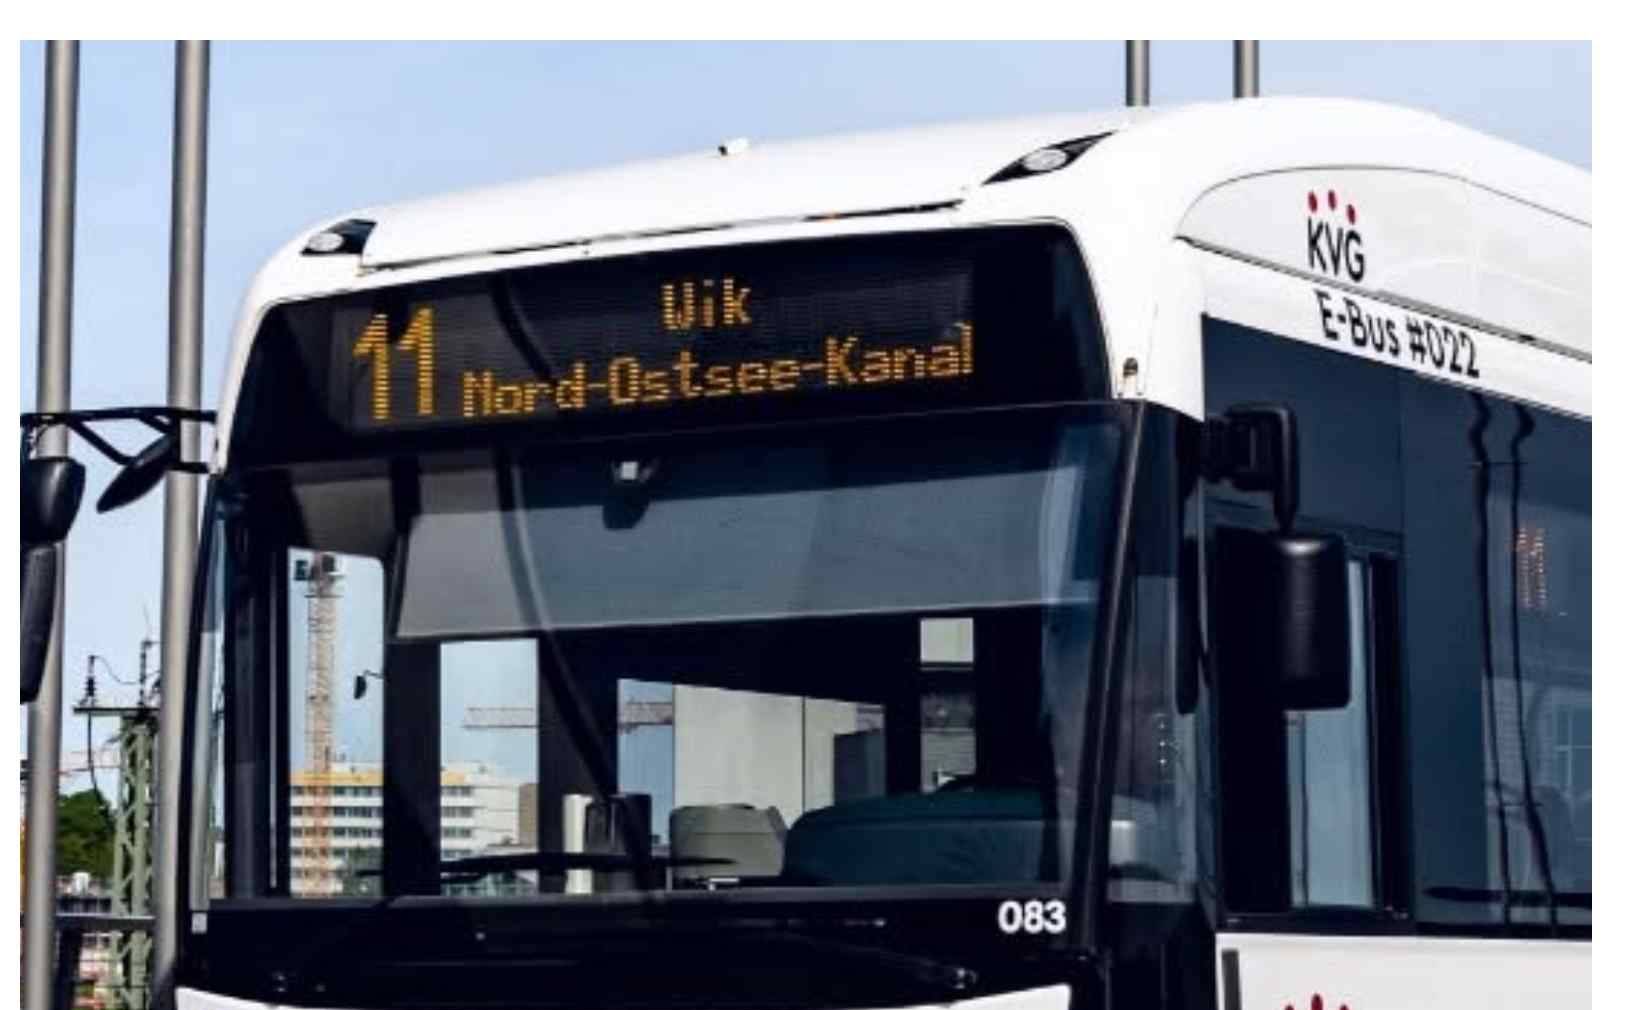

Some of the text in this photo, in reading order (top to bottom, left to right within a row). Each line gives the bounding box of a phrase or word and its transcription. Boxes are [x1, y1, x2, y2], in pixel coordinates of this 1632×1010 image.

[1307, 216, 1364, 283] KVG
[661, 278, 752, 330] Wik
[1314, 288, 1480, 379] E-Bus #022
[353, 307, 435, 420] 11
[463, 322, 974, 418] Nord-Ostsee-Kanal
[997, 898, 1067, 935] 083
